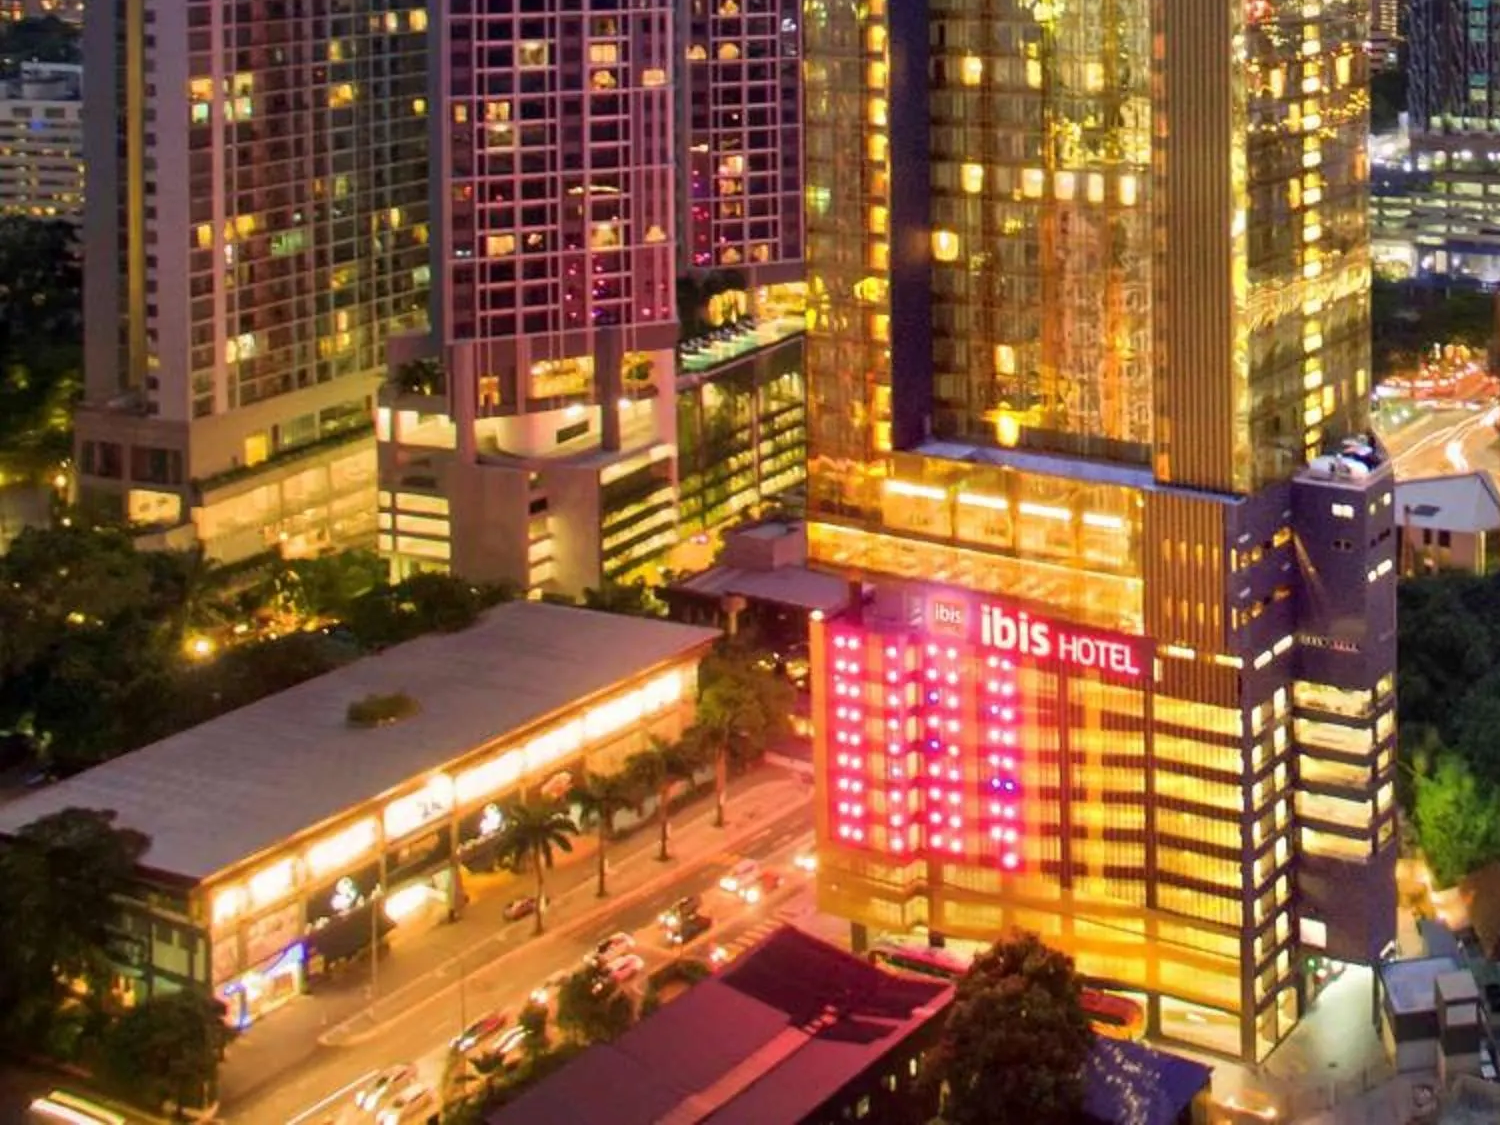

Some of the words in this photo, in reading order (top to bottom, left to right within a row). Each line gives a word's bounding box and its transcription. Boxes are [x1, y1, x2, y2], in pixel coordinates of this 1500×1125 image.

[935, 603, 962, 624] ibis
[981, 604, 1051, 656] ibis
[1058, 633, 1140, 675] HOTEL
